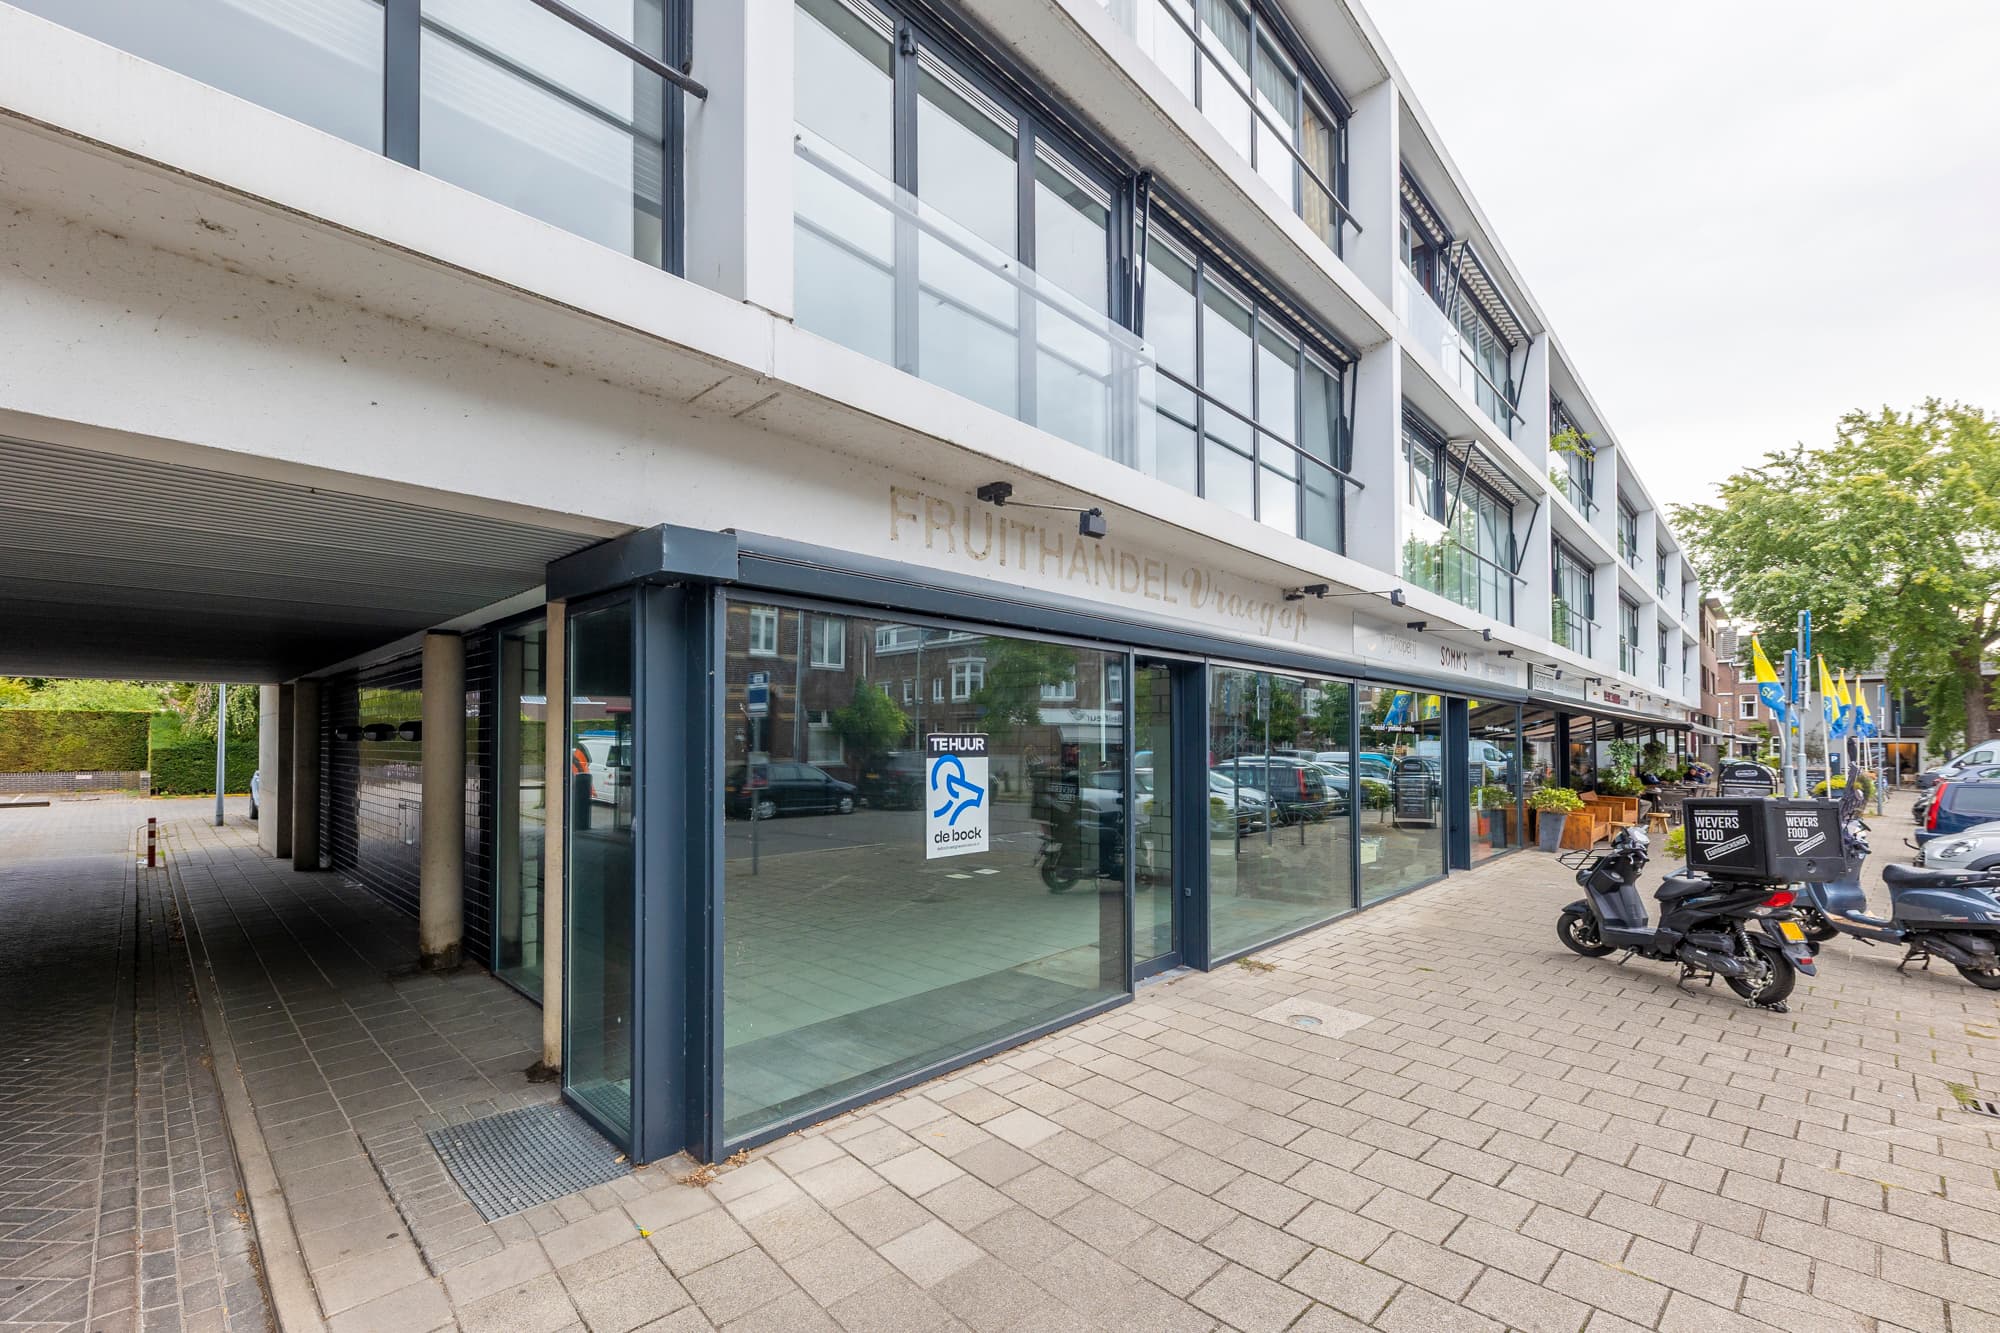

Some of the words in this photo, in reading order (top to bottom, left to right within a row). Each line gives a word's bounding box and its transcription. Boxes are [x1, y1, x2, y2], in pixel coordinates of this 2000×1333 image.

[889, 484, 1178, 604] FRUITHANDEL
[1440, 645, 1468, 672] SOMM'S
[1694, 816, 1740, 829] WEVERS
[1785, 816, 1819, 828] WEVERS
[934, 830, 950, 844] de
[952, 826, 982, 842] bock
[1696, 828, 1724, 841] FOOD
[1787, 827, 1809, 839] FOOD
